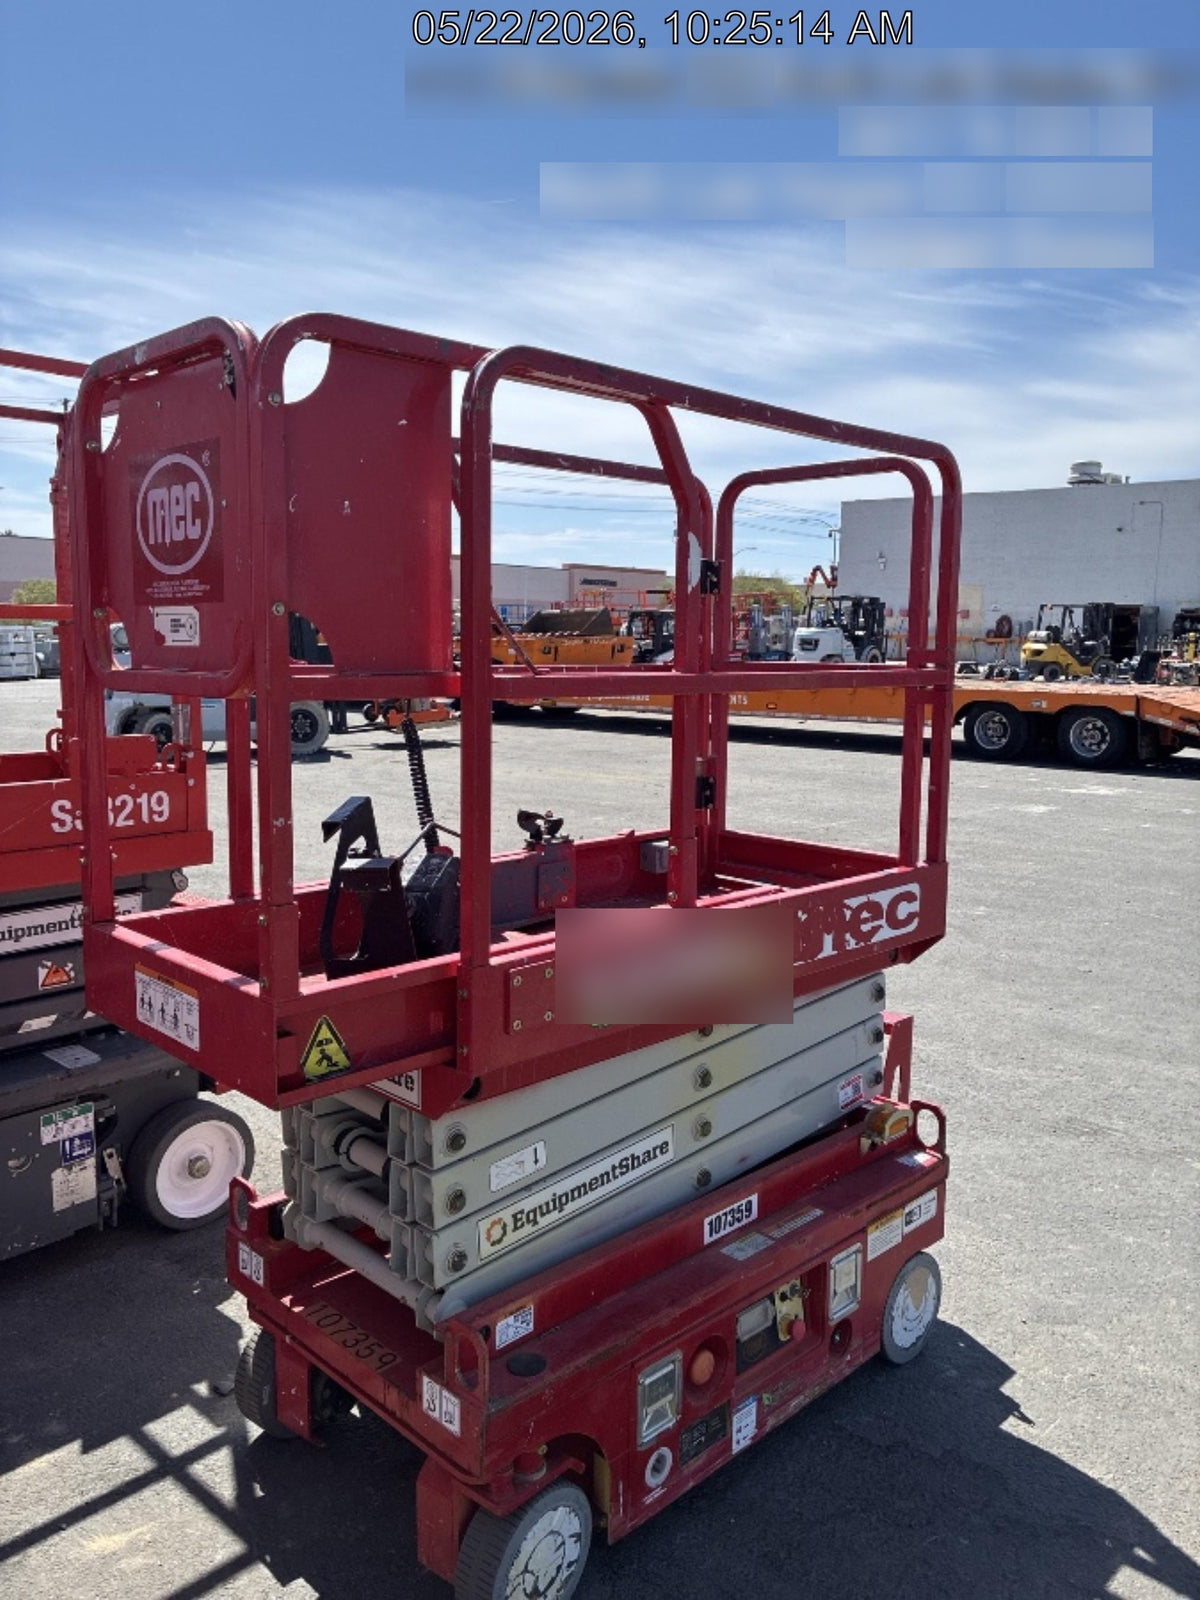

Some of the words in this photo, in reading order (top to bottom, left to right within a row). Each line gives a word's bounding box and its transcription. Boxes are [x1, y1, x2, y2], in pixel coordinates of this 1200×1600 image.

[511, 1139, 670, 1233] EquipmentShare
[707, 1199, 753, 1238] 107359
[305, 1304, 398, 1372] 107359
